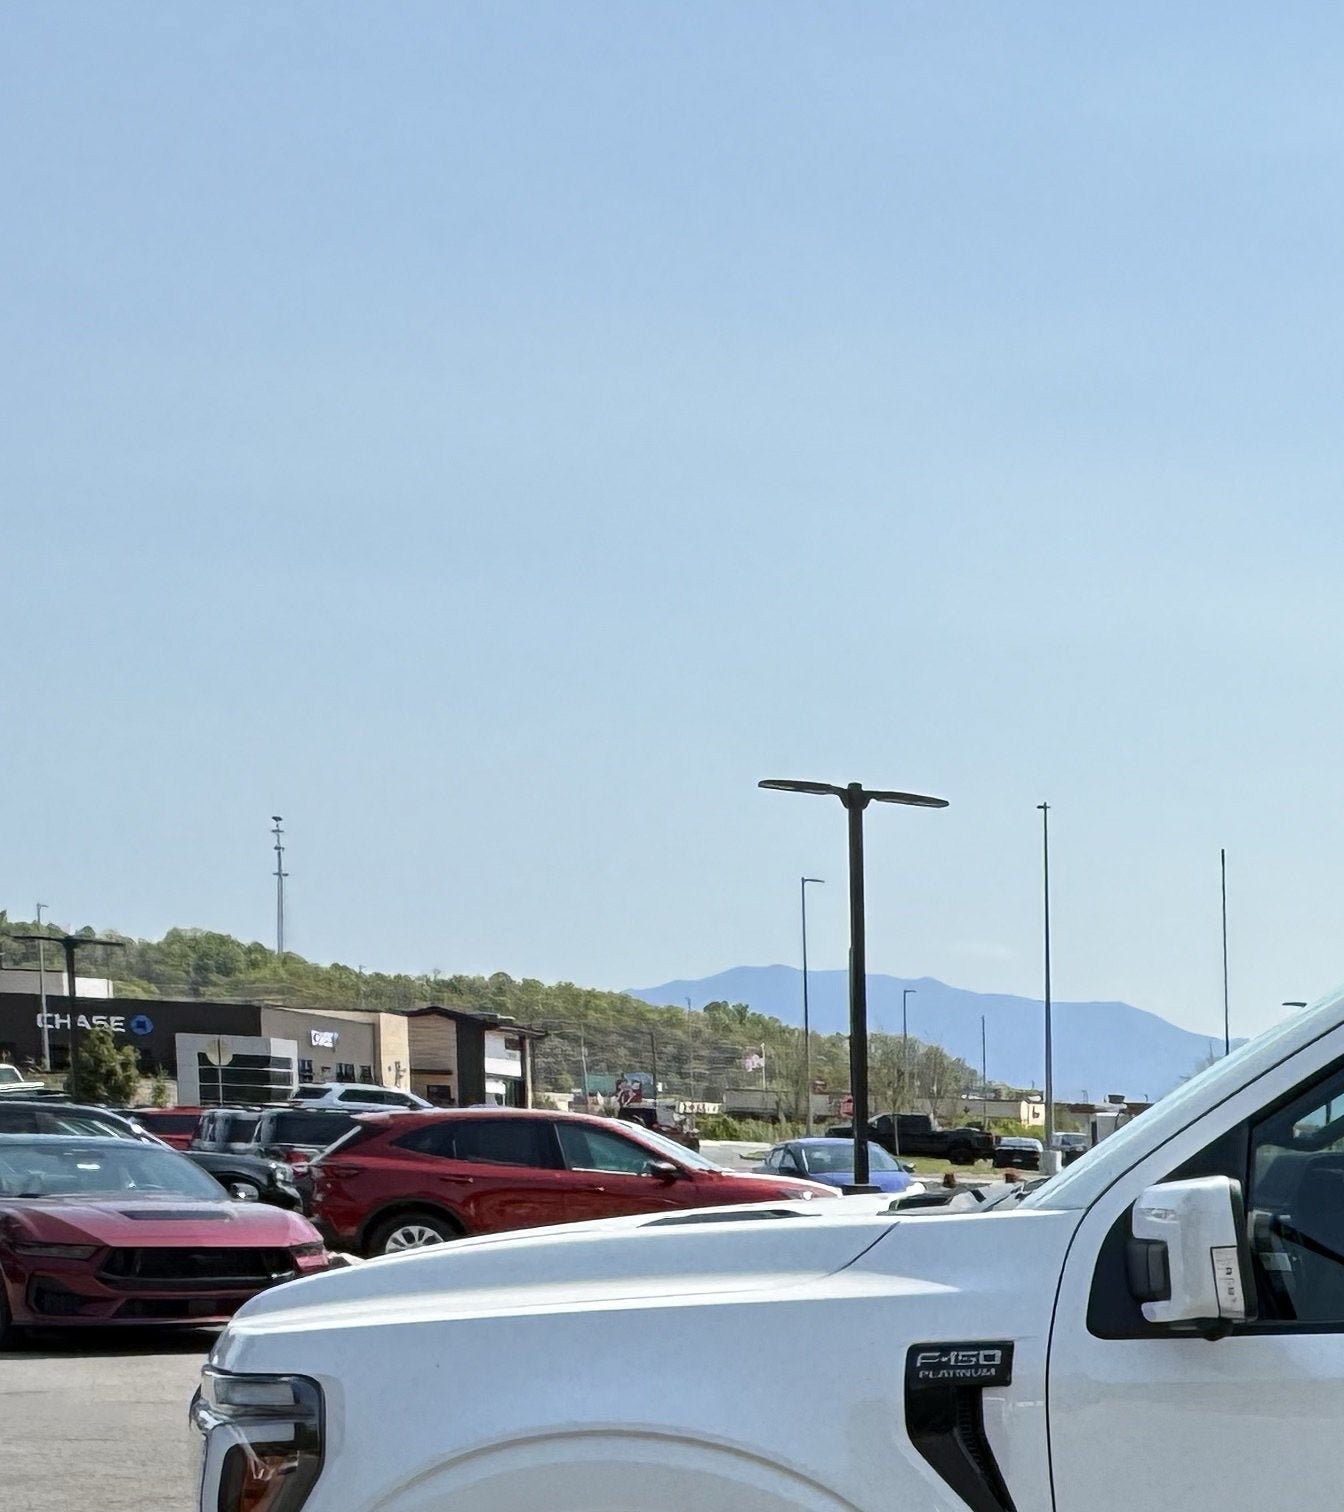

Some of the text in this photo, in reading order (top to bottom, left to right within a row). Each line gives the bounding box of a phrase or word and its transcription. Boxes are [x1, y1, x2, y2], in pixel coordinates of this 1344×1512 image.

[36, 1013, 126, 1032] CHASE
[916, 1349, 1002, 1367] F-150
[918, 1367, 996, 1379] PLATINUM
